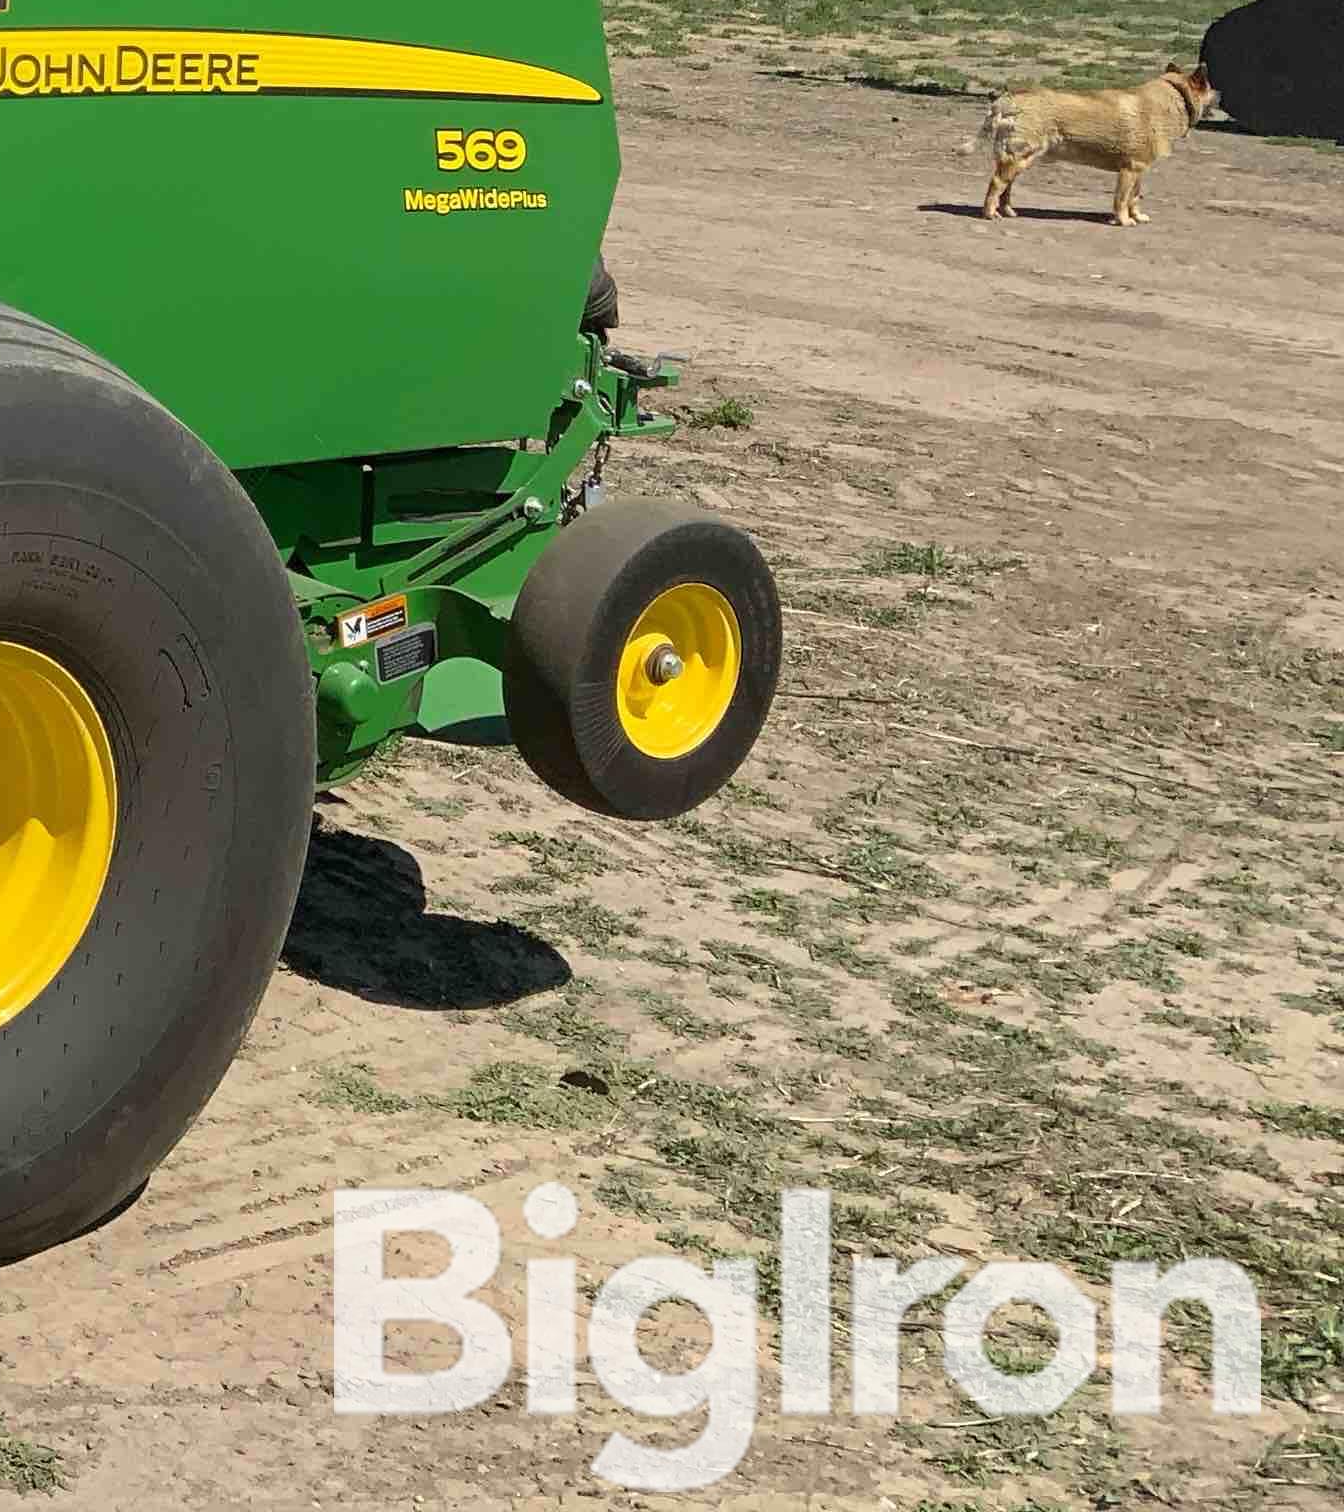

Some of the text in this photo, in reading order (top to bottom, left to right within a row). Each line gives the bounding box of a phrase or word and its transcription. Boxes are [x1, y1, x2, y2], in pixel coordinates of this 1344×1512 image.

[116, 45, 260, 87] DEERE
[435, 128, 528, 172] 569
[403, 187, 549, 216] MegaWidePlus
